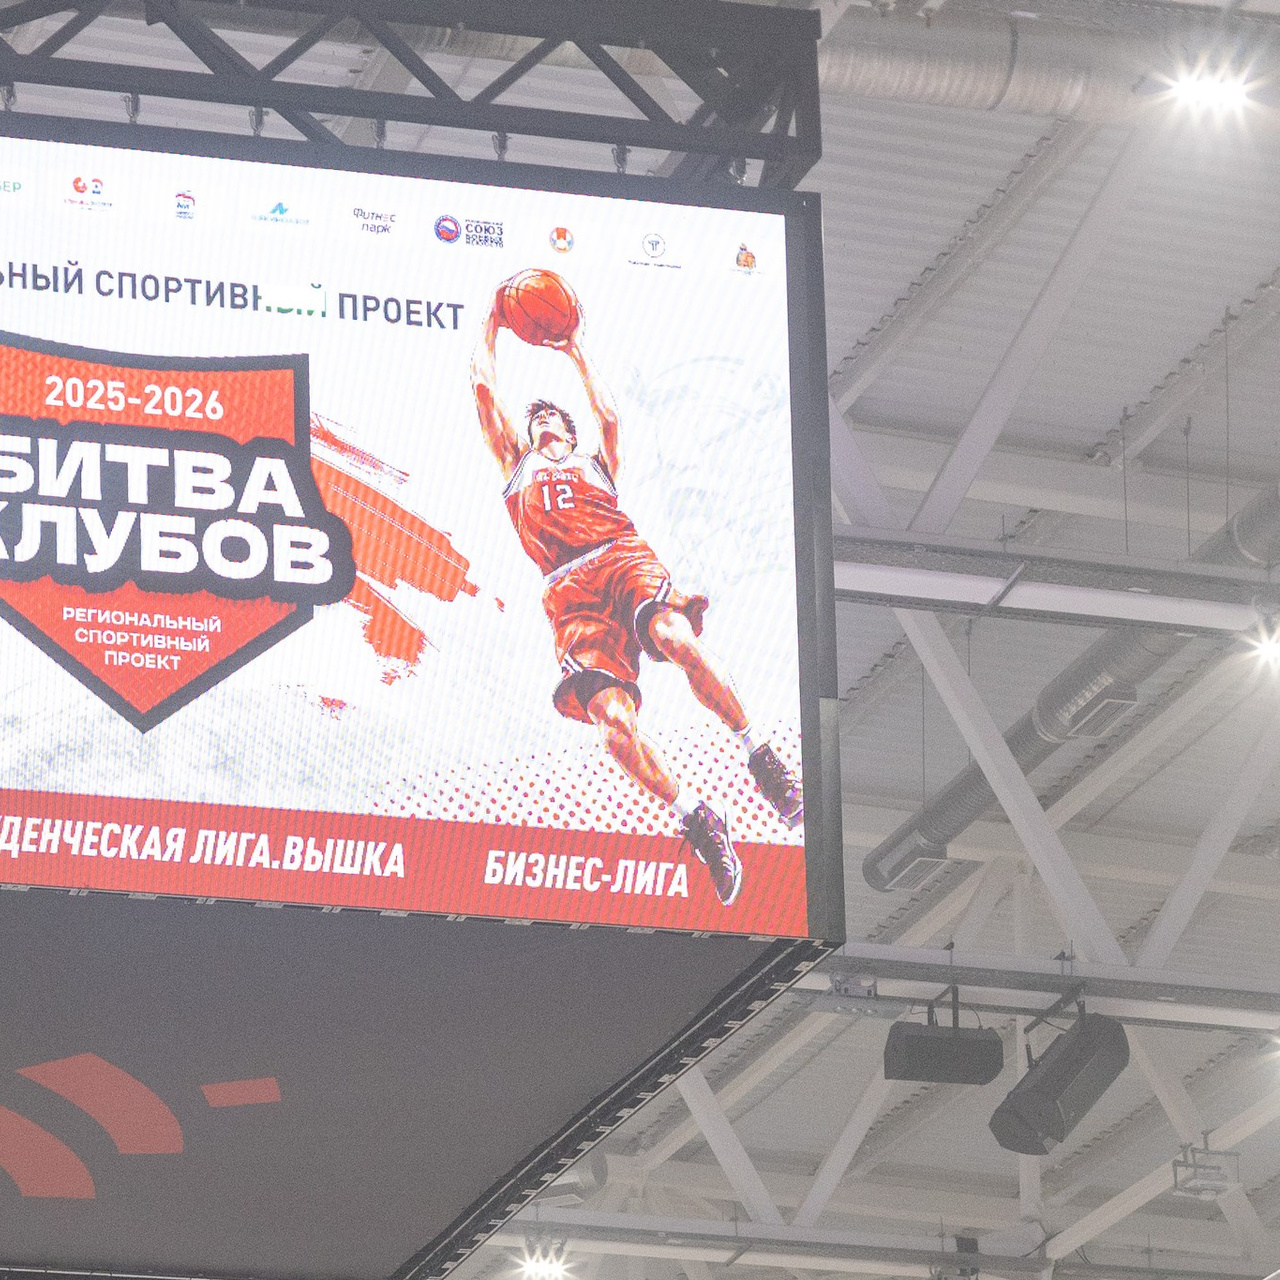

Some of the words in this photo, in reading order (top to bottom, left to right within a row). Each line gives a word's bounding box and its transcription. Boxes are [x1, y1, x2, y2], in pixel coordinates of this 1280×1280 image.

[465, 223, 503, 236] СОЮЗ
[338, 292, 464, 331] ПРОЕКТ
[44, 375, 225, 421] 2025-2026
[62, 605, 222, 633] РЕГИОНАЛЬНЫЙ
[74, 627, 211, 653] СПОРТИВНЫЙ
[104, 650, 181, 671] ПРОЕКТ
[484, 849, 690, 898] БИЗНЕС-ЛИГА
